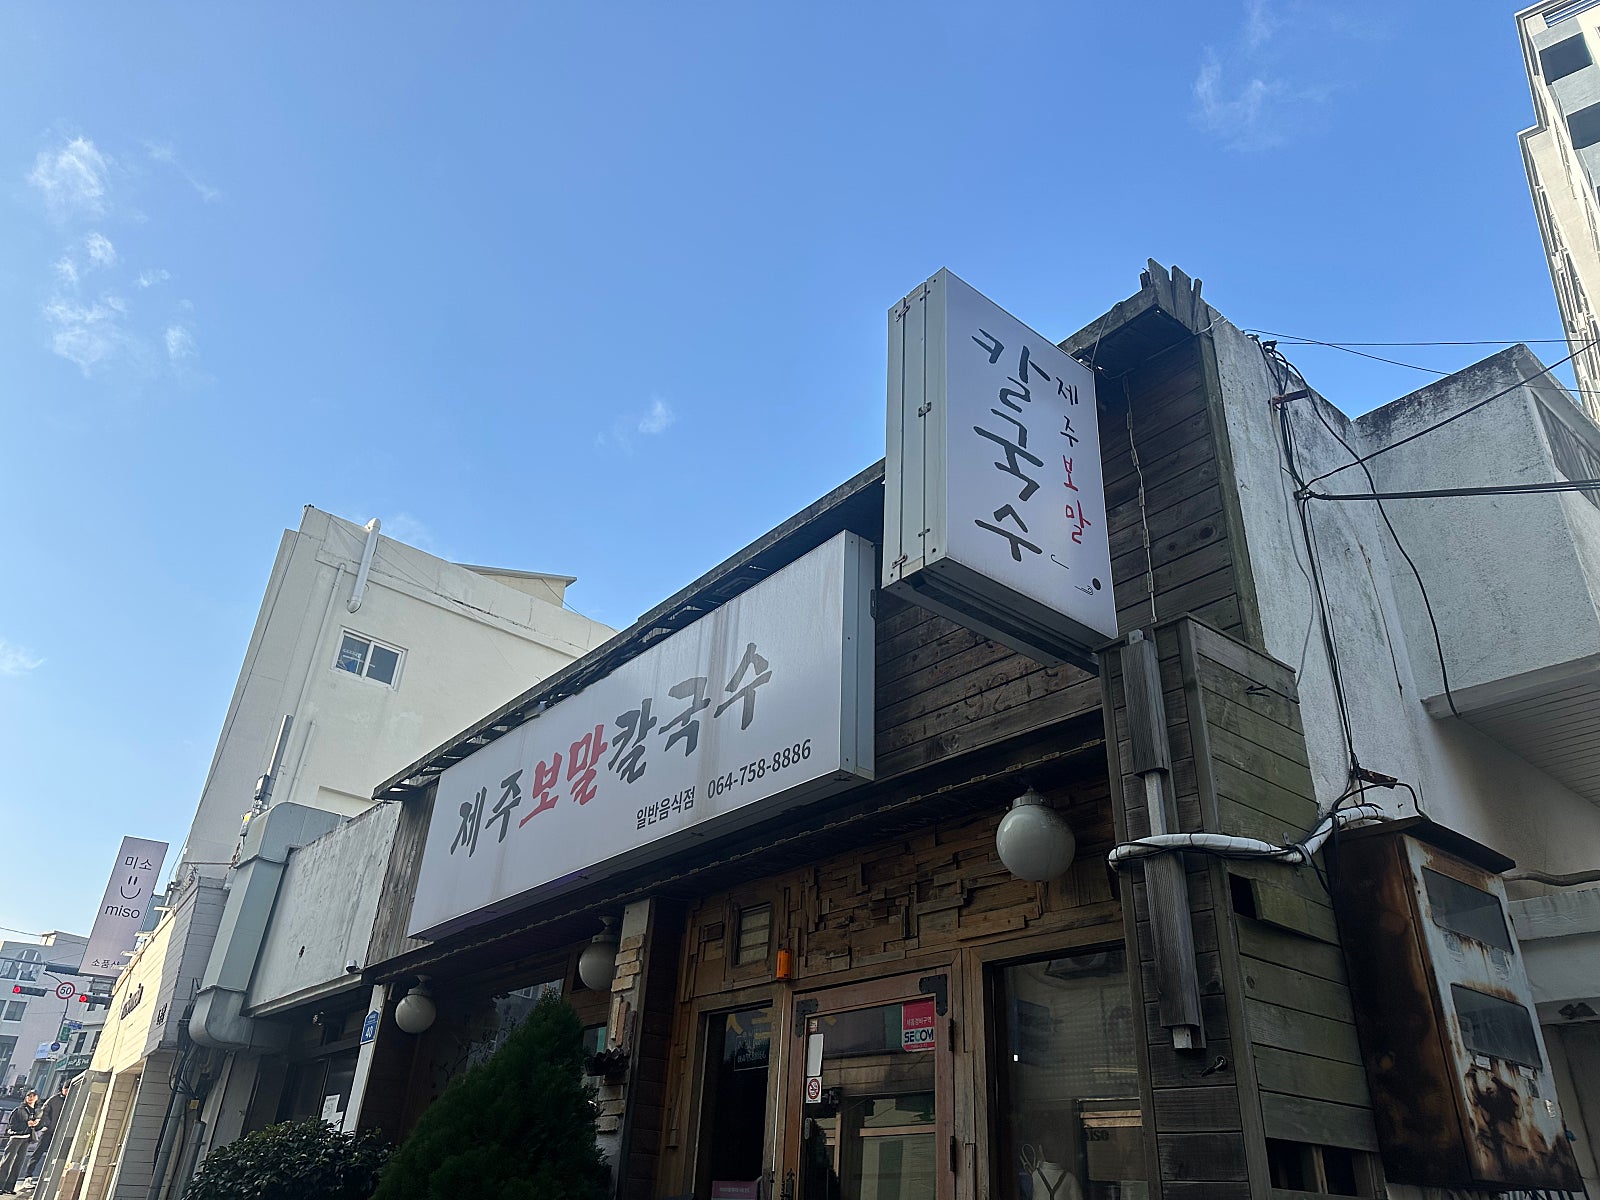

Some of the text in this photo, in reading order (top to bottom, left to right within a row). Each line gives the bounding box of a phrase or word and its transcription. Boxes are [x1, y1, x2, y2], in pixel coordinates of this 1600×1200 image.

[971, 328, 1051, 562] 칼국수
[636, 739, 811, 830] 일반음식점 064-758-8886
[125, 856, 152, 871] 미소
[105, 905, 140, 919] miso
[60, 986, 72, 995] 50
[904, 1029, 934, 1043] SECOM
